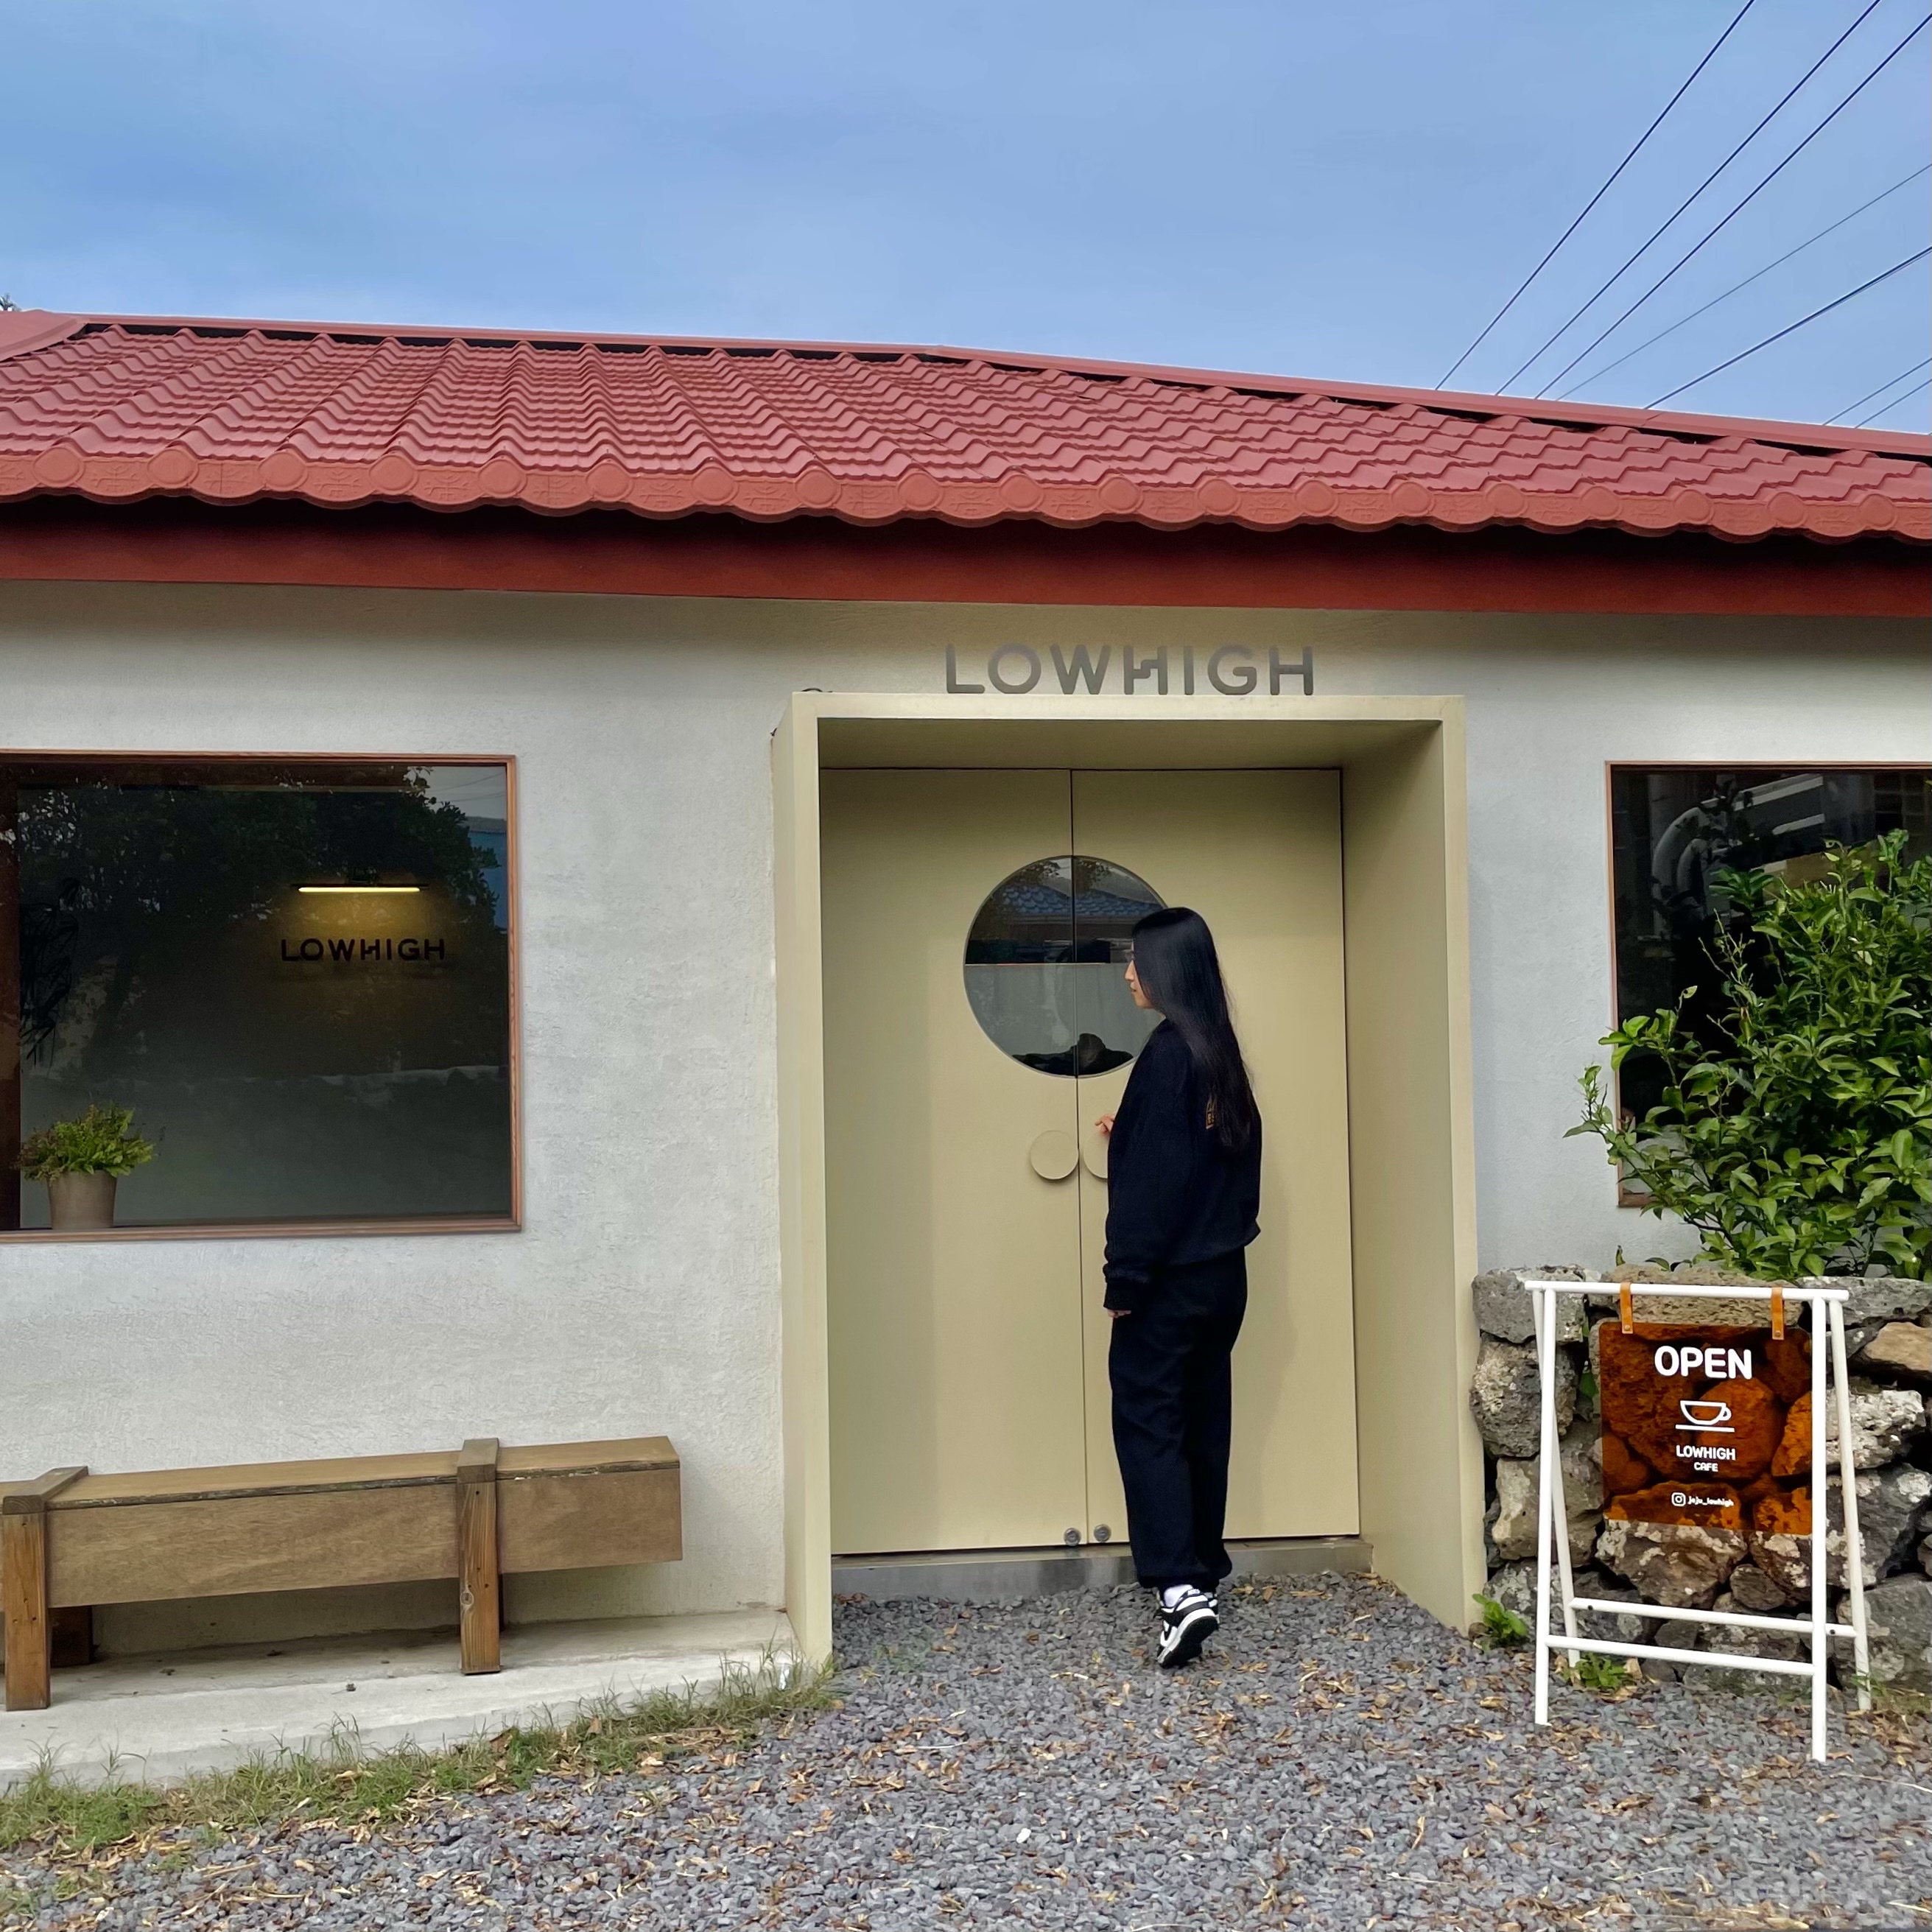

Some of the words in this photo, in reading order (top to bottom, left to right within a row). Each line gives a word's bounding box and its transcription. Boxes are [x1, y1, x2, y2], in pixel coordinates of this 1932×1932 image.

[946, 644, 1313, 695] LOWHIGH
[281, 938, 445, 961] LOWHIGH
[1654, 1345, 1752, 1380] OPEN
[1676, 1444, 1736, 1461] LOWHIGH
[1693, 1461, 1718, 1472] CAFE
